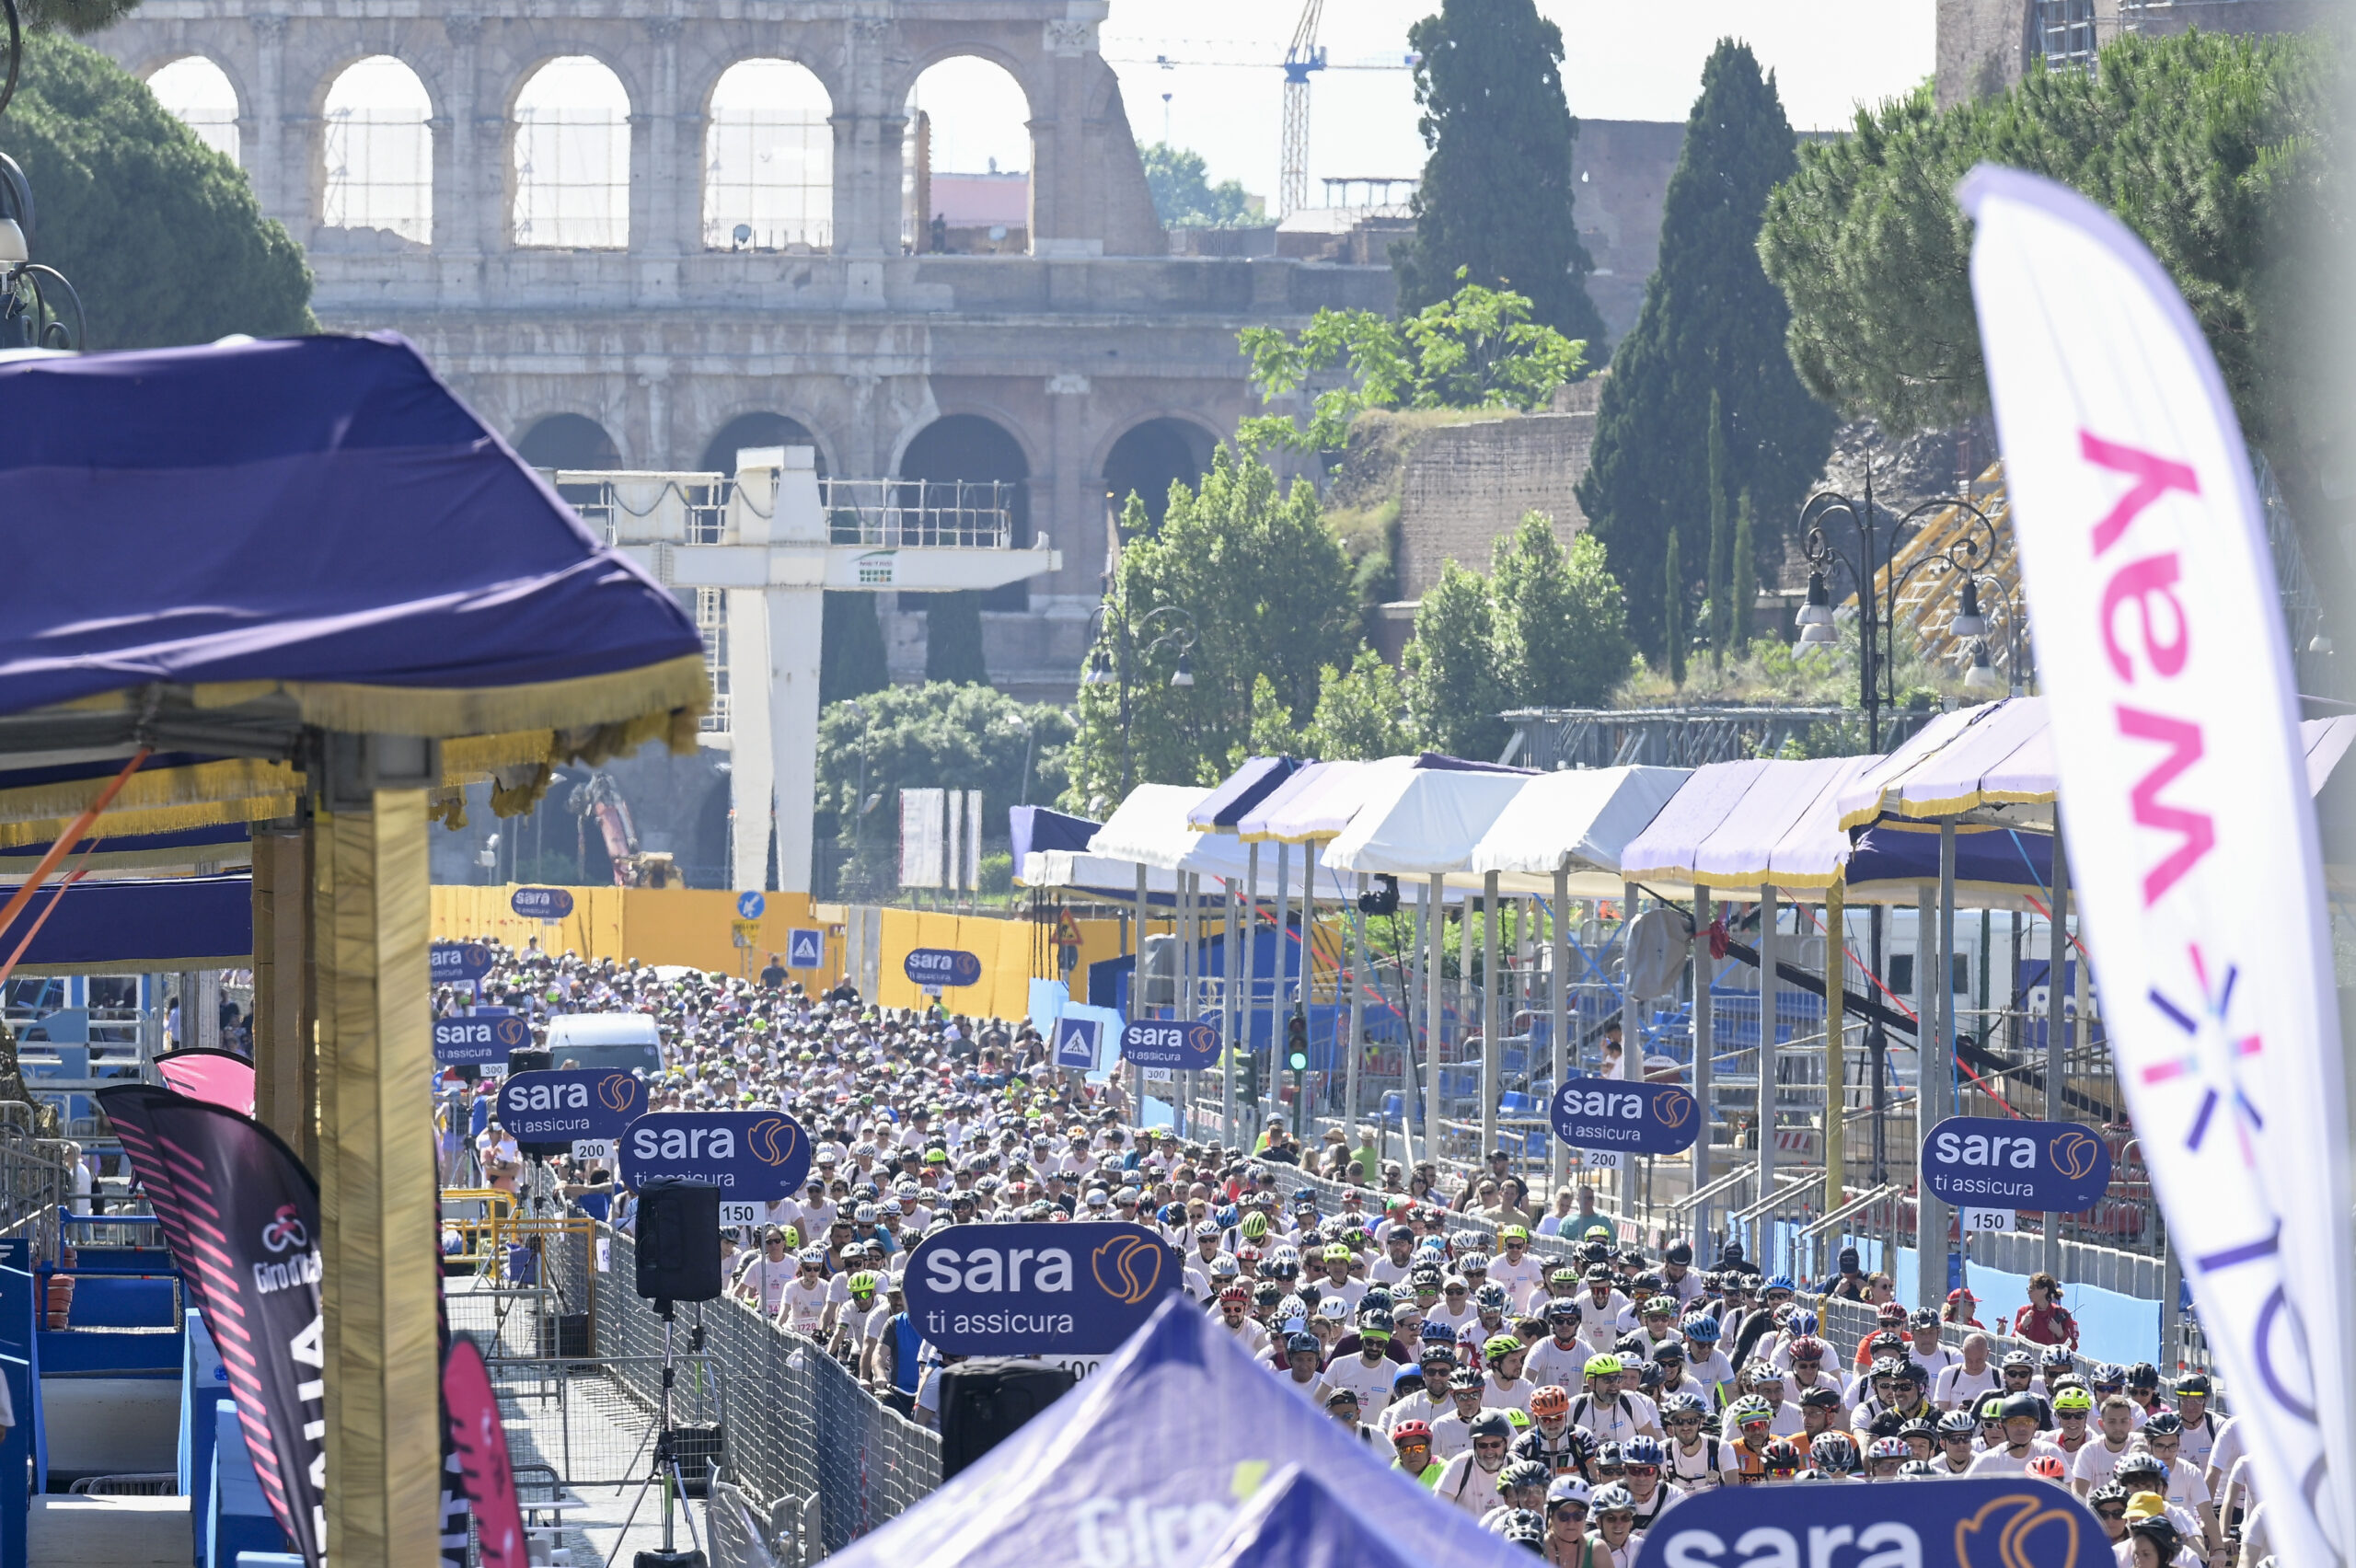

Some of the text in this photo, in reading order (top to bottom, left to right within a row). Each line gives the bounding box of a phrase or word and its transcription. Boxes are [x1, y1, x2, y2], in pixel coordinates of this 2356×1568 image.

[2078, 425, 2217, 909] way
[515, 892, 550, 905] sara
[432, 951, 462, 965] ara
[909, 953, 952, 970] sara
[436, 1024, 491, 1043] sara
[1128, 1027, 1183, 1047] sara
[438, 1047, 492, 1059] ti assicura
[1127, 1050, 1181, 1062] ti assicura
[485, 1066, 502, 1075] 300
[1148, 1070, 1165, 1078] 300
[508, 1083, 589, 1112] sara
[1563, 1090, 1643, 1119] sara
[510, 1117, 590, 1134] ti assicura
[1562, 1122, 1641, 1142] ti assicura
[579, 1144, 605, 1158] 200
[633, 1127, 734, 1159] sara
[1935, 1132, 2037, 1169] sara
[1590, 1152, 1616, 1167] 200
[1934, 1174, 2034, 1197] ti assicura
[722, 1205, 755, 1221] 150
[1973, 1213, 2004, 1229] 150
[253, 1262, 290, 1294] Giro
[926, 1247, 1073, 1293] sara
[926, 1309, 1074, 1333] ti assicura
[1664, 1521, 1923, 1568] sara
